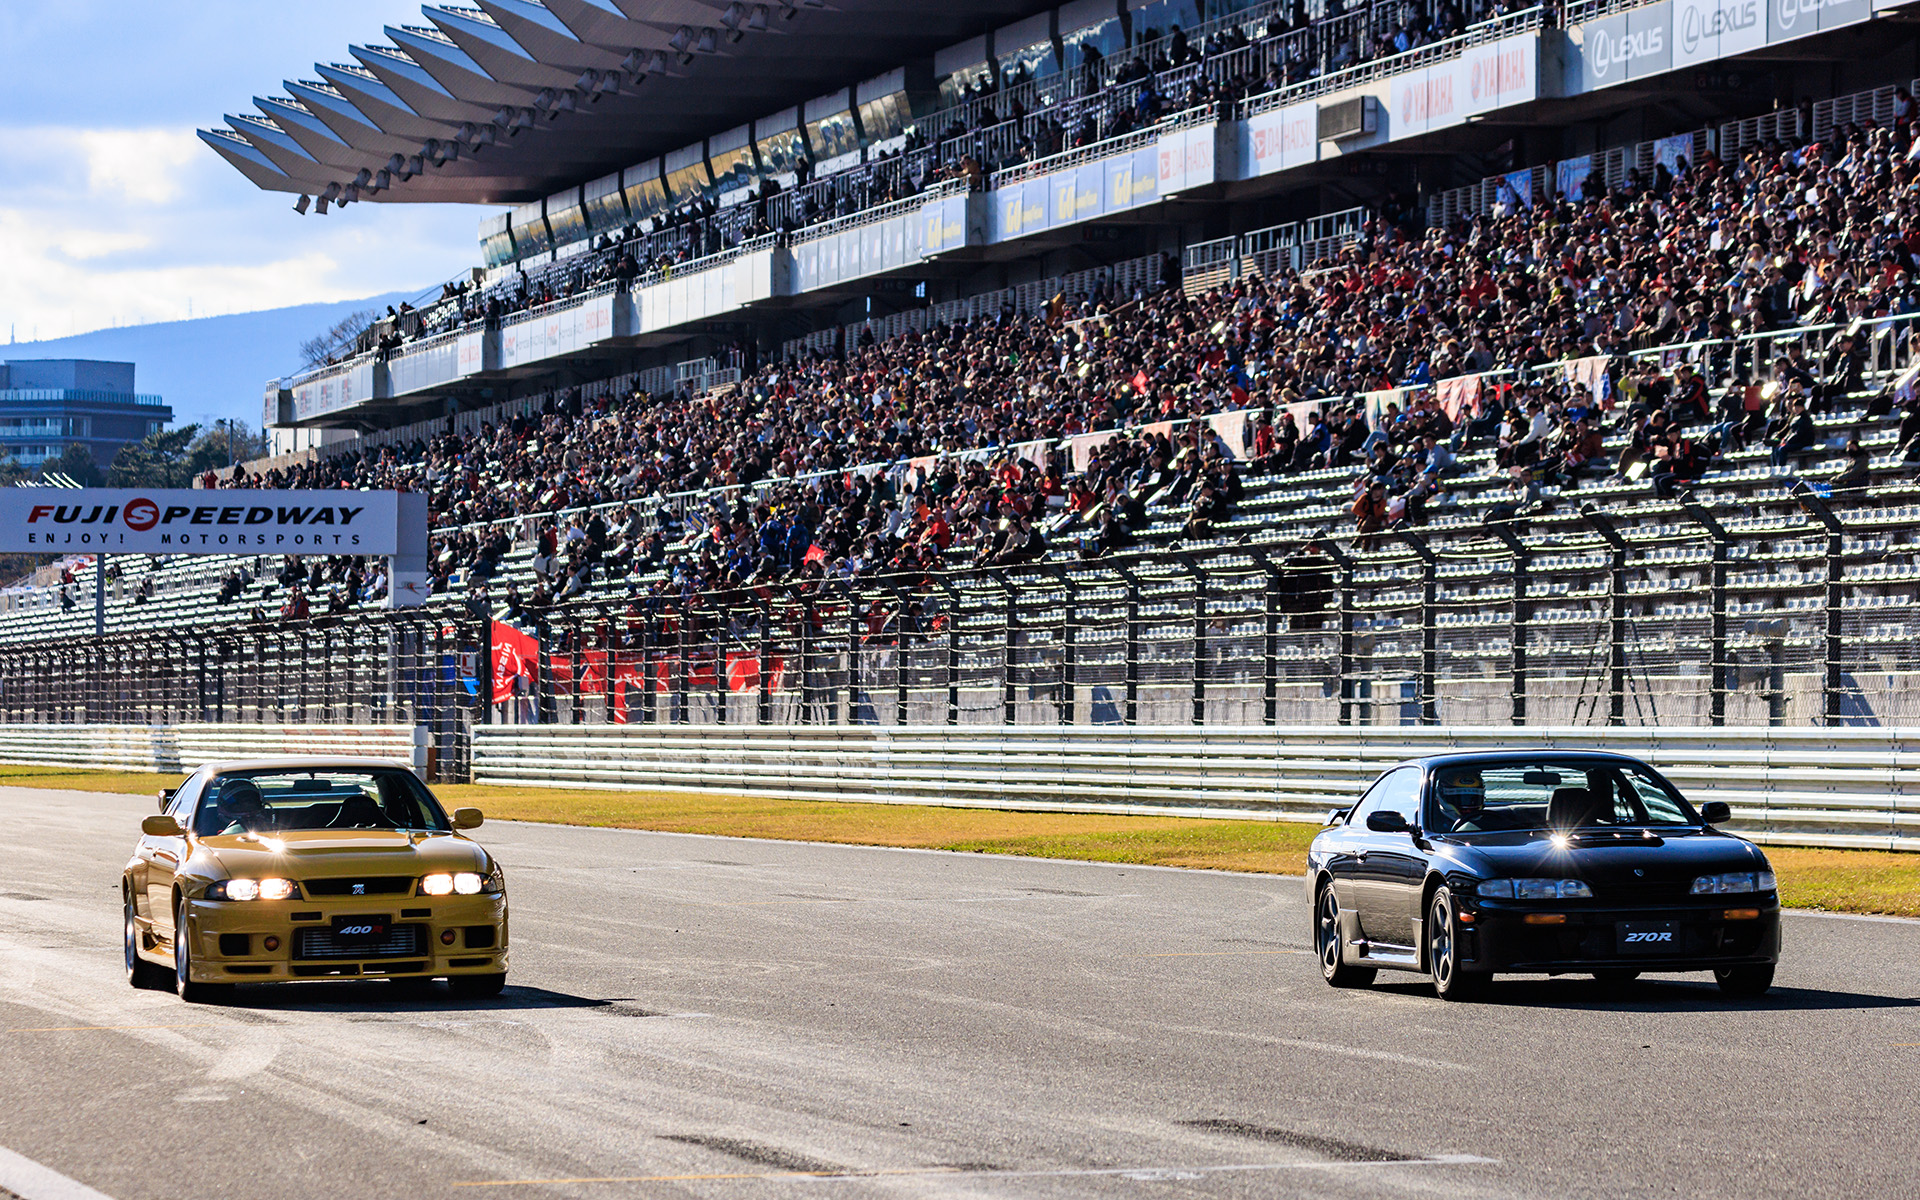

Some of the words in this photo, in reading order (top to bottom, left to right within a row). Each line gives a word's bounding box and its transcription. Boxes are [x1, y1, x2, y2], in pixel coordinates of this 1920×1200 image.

[1700, 1, 1756, 38] LEXUS
[1611, 26, 1663, 64] LEXUS
[1482, 48, 1526, 97] YAMAHA
[1411, 74, 1454, 122] YAMAHA
[1267, 118, 1312, 157] DAIHATSU
[1171, 139, 1212, 176] DAIHATSU
[27, 505, 120, 524] FUJI
[125, 503, 364, 527] SPEEDWAY
[28, 533, 124, 544] ENJOY!
[161, 533, 361, 545] MOTORSPORTS
[339, 925, 383, 935] 400R
[1624, 932, 1672, 942] 270R
